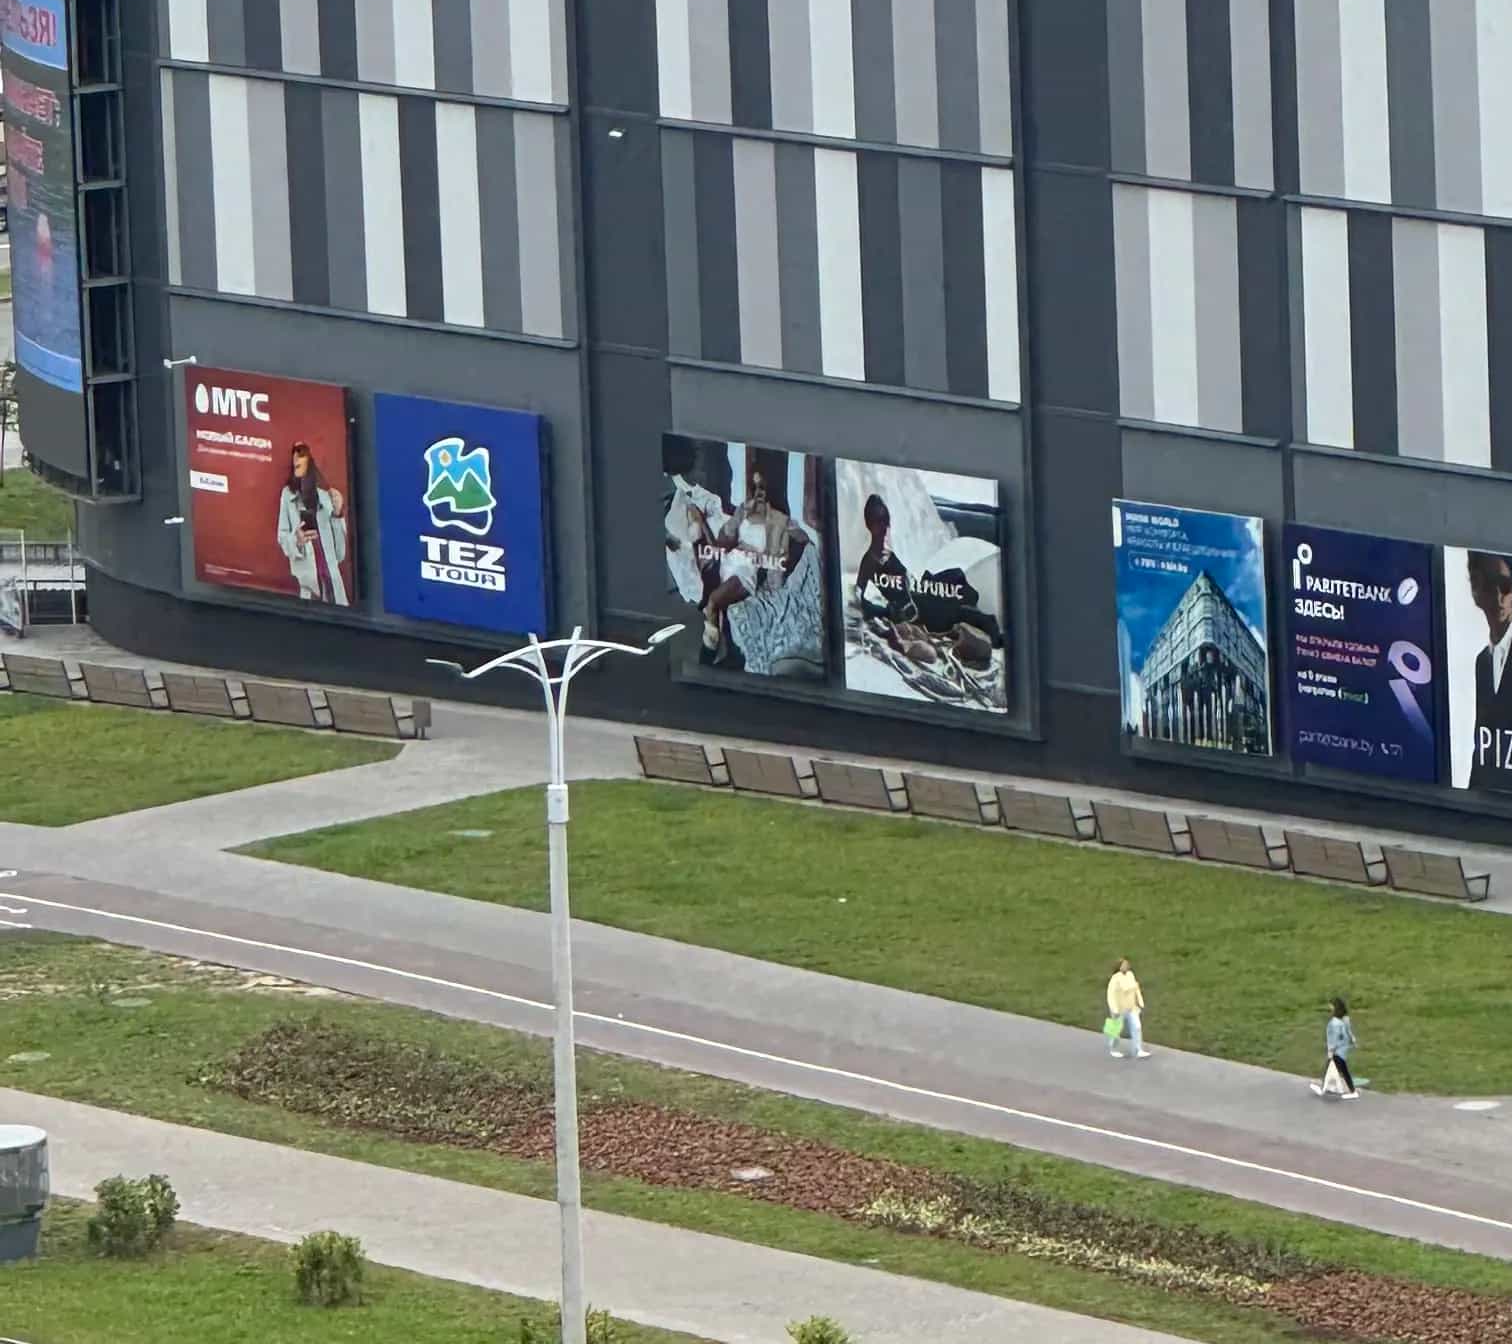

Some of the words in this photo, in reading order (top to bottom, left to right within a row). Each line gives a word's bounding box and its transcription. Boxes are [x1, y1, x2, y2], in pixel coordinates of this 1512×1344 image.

[212, 386, 270, 421] МТС
[420, 536, 505, 572] TEZ
[430, 565, 497, 587] TOUR
[873, 572, 904, 590] LOVE
[909, 575, 964, 600] REPUBLIC
[1305, 575, 1393, 603] PARITETBANK
[1294, 598, 1345, 620] ЗДЕСЬ!
